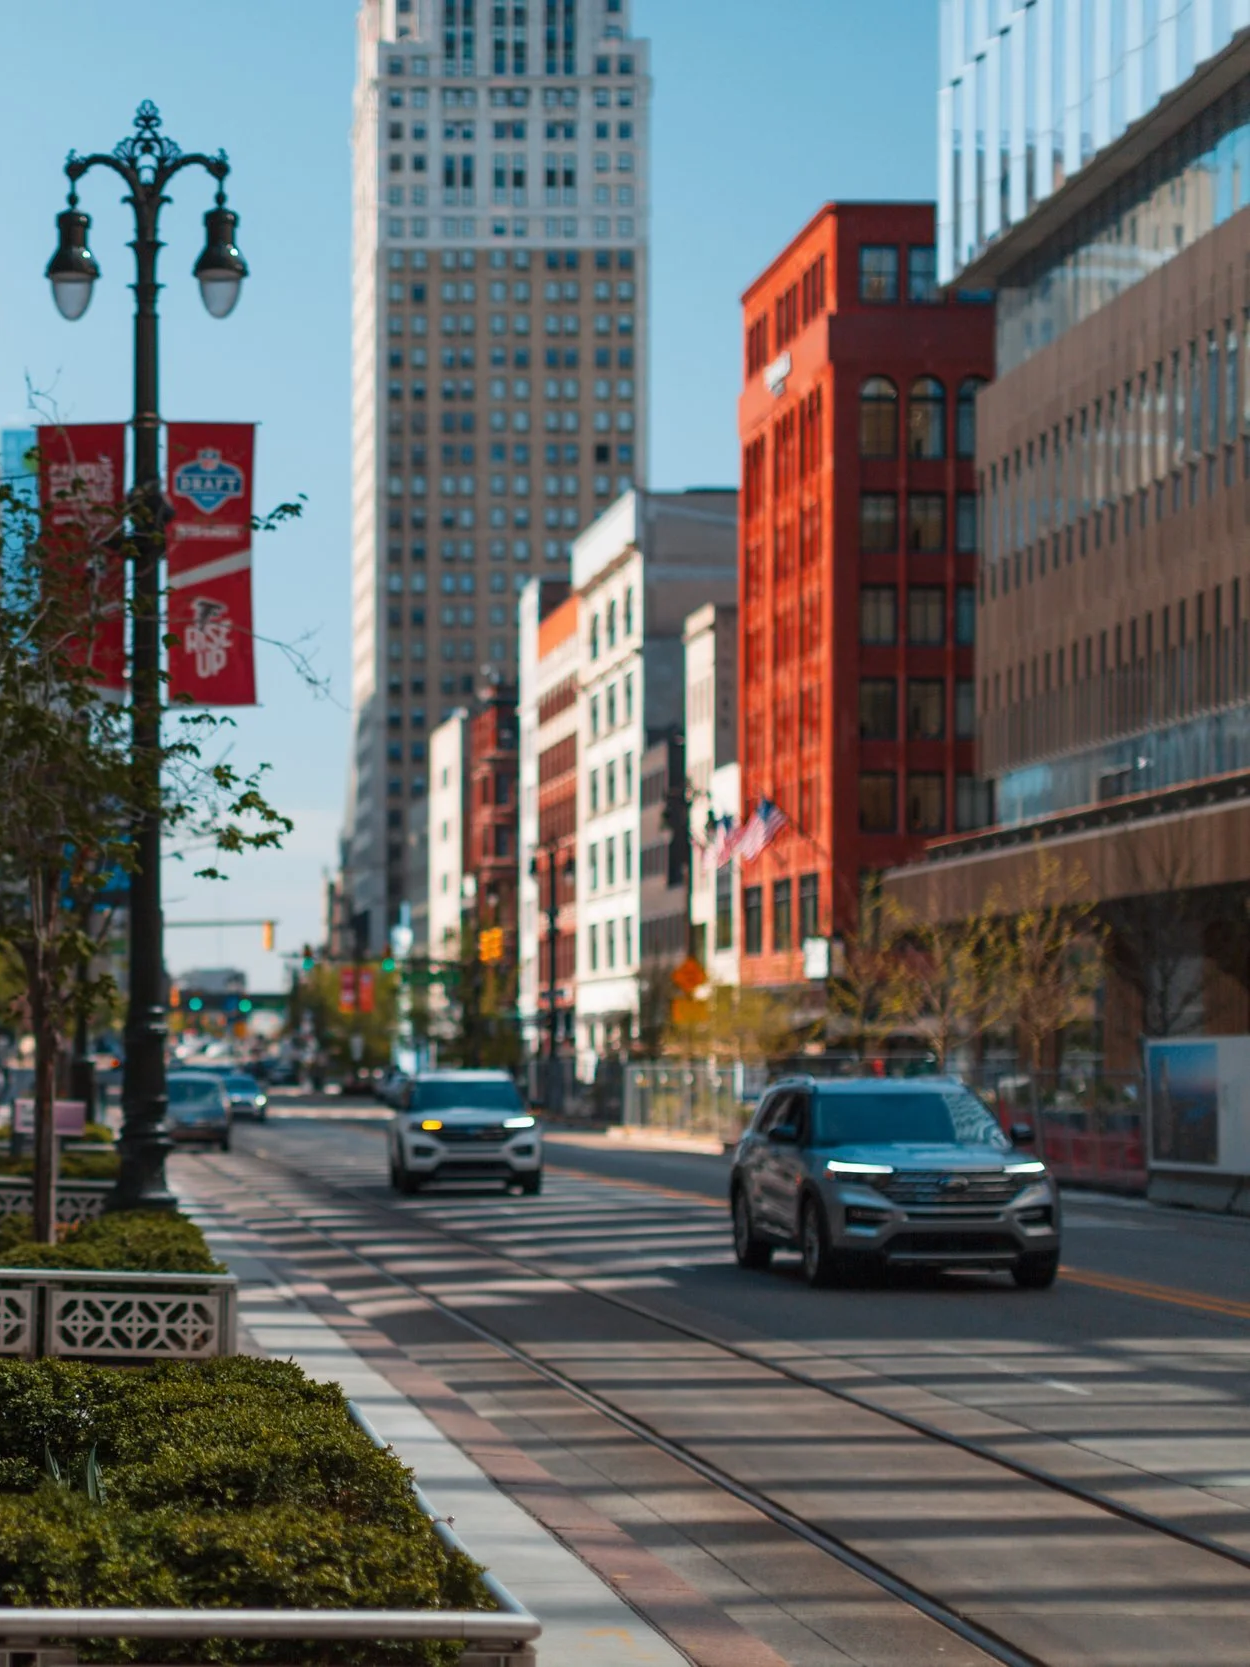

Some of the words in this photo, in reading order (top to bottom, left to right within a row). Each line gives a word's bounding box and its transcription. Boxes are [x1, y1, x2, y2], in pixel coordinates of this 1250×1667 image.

[180, 476, 238, 490] DRAFT
[185, 620, 233, 654] RISE
[196, 650, 227, 679] UP
